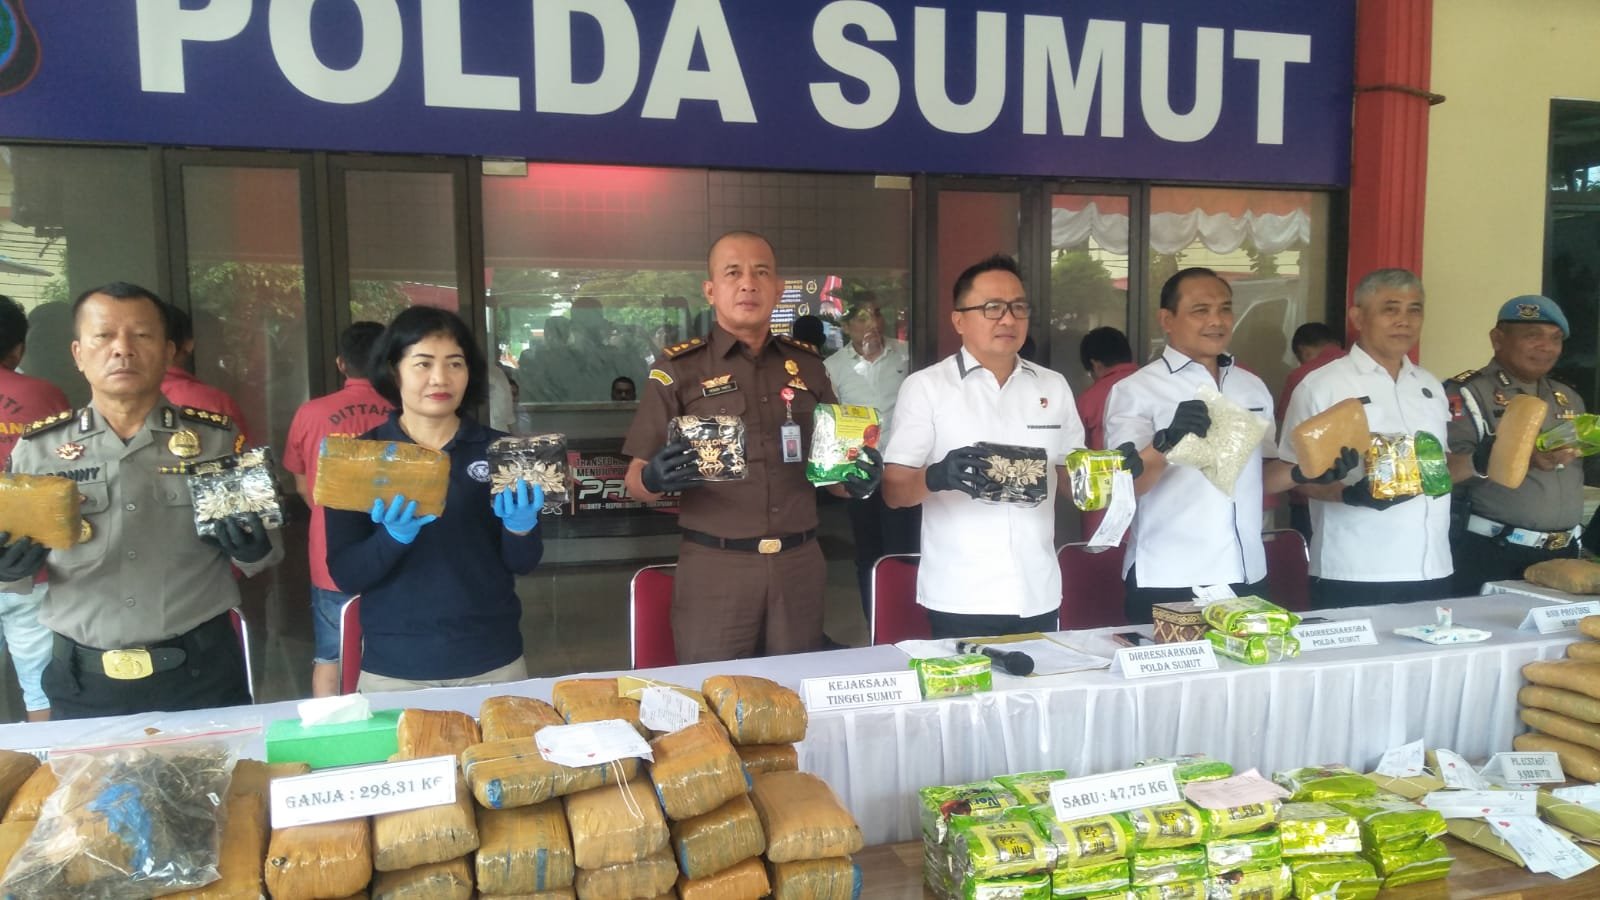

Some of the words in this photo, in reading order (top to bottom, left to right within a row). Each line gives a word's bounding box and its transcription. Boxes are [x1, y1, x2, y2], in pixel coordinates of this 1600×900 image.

[136, 0, 758, 124] POLDA
[808, 0, 1312, 146] SUMUT
[1129, 645, 1206, 661] DIRRESNARKOBA
[1140, 662, 1170, 673] POLDA
[1173, 658, 1201, 670] SUMUT
[828, 677, 897, 691] KEJAKSAAN
[827, 693, 865, 705] TINGGI
[866, 690, 903, 702] SUMUT
[285, 789, 345, 809] GANJA
[360, 780, 415, 800] 298,31
[1062, 791, 1100, 809] SABU
[1110, 783, 1146, 800] 47,75
[1148, 780, 1169, 794] KG
